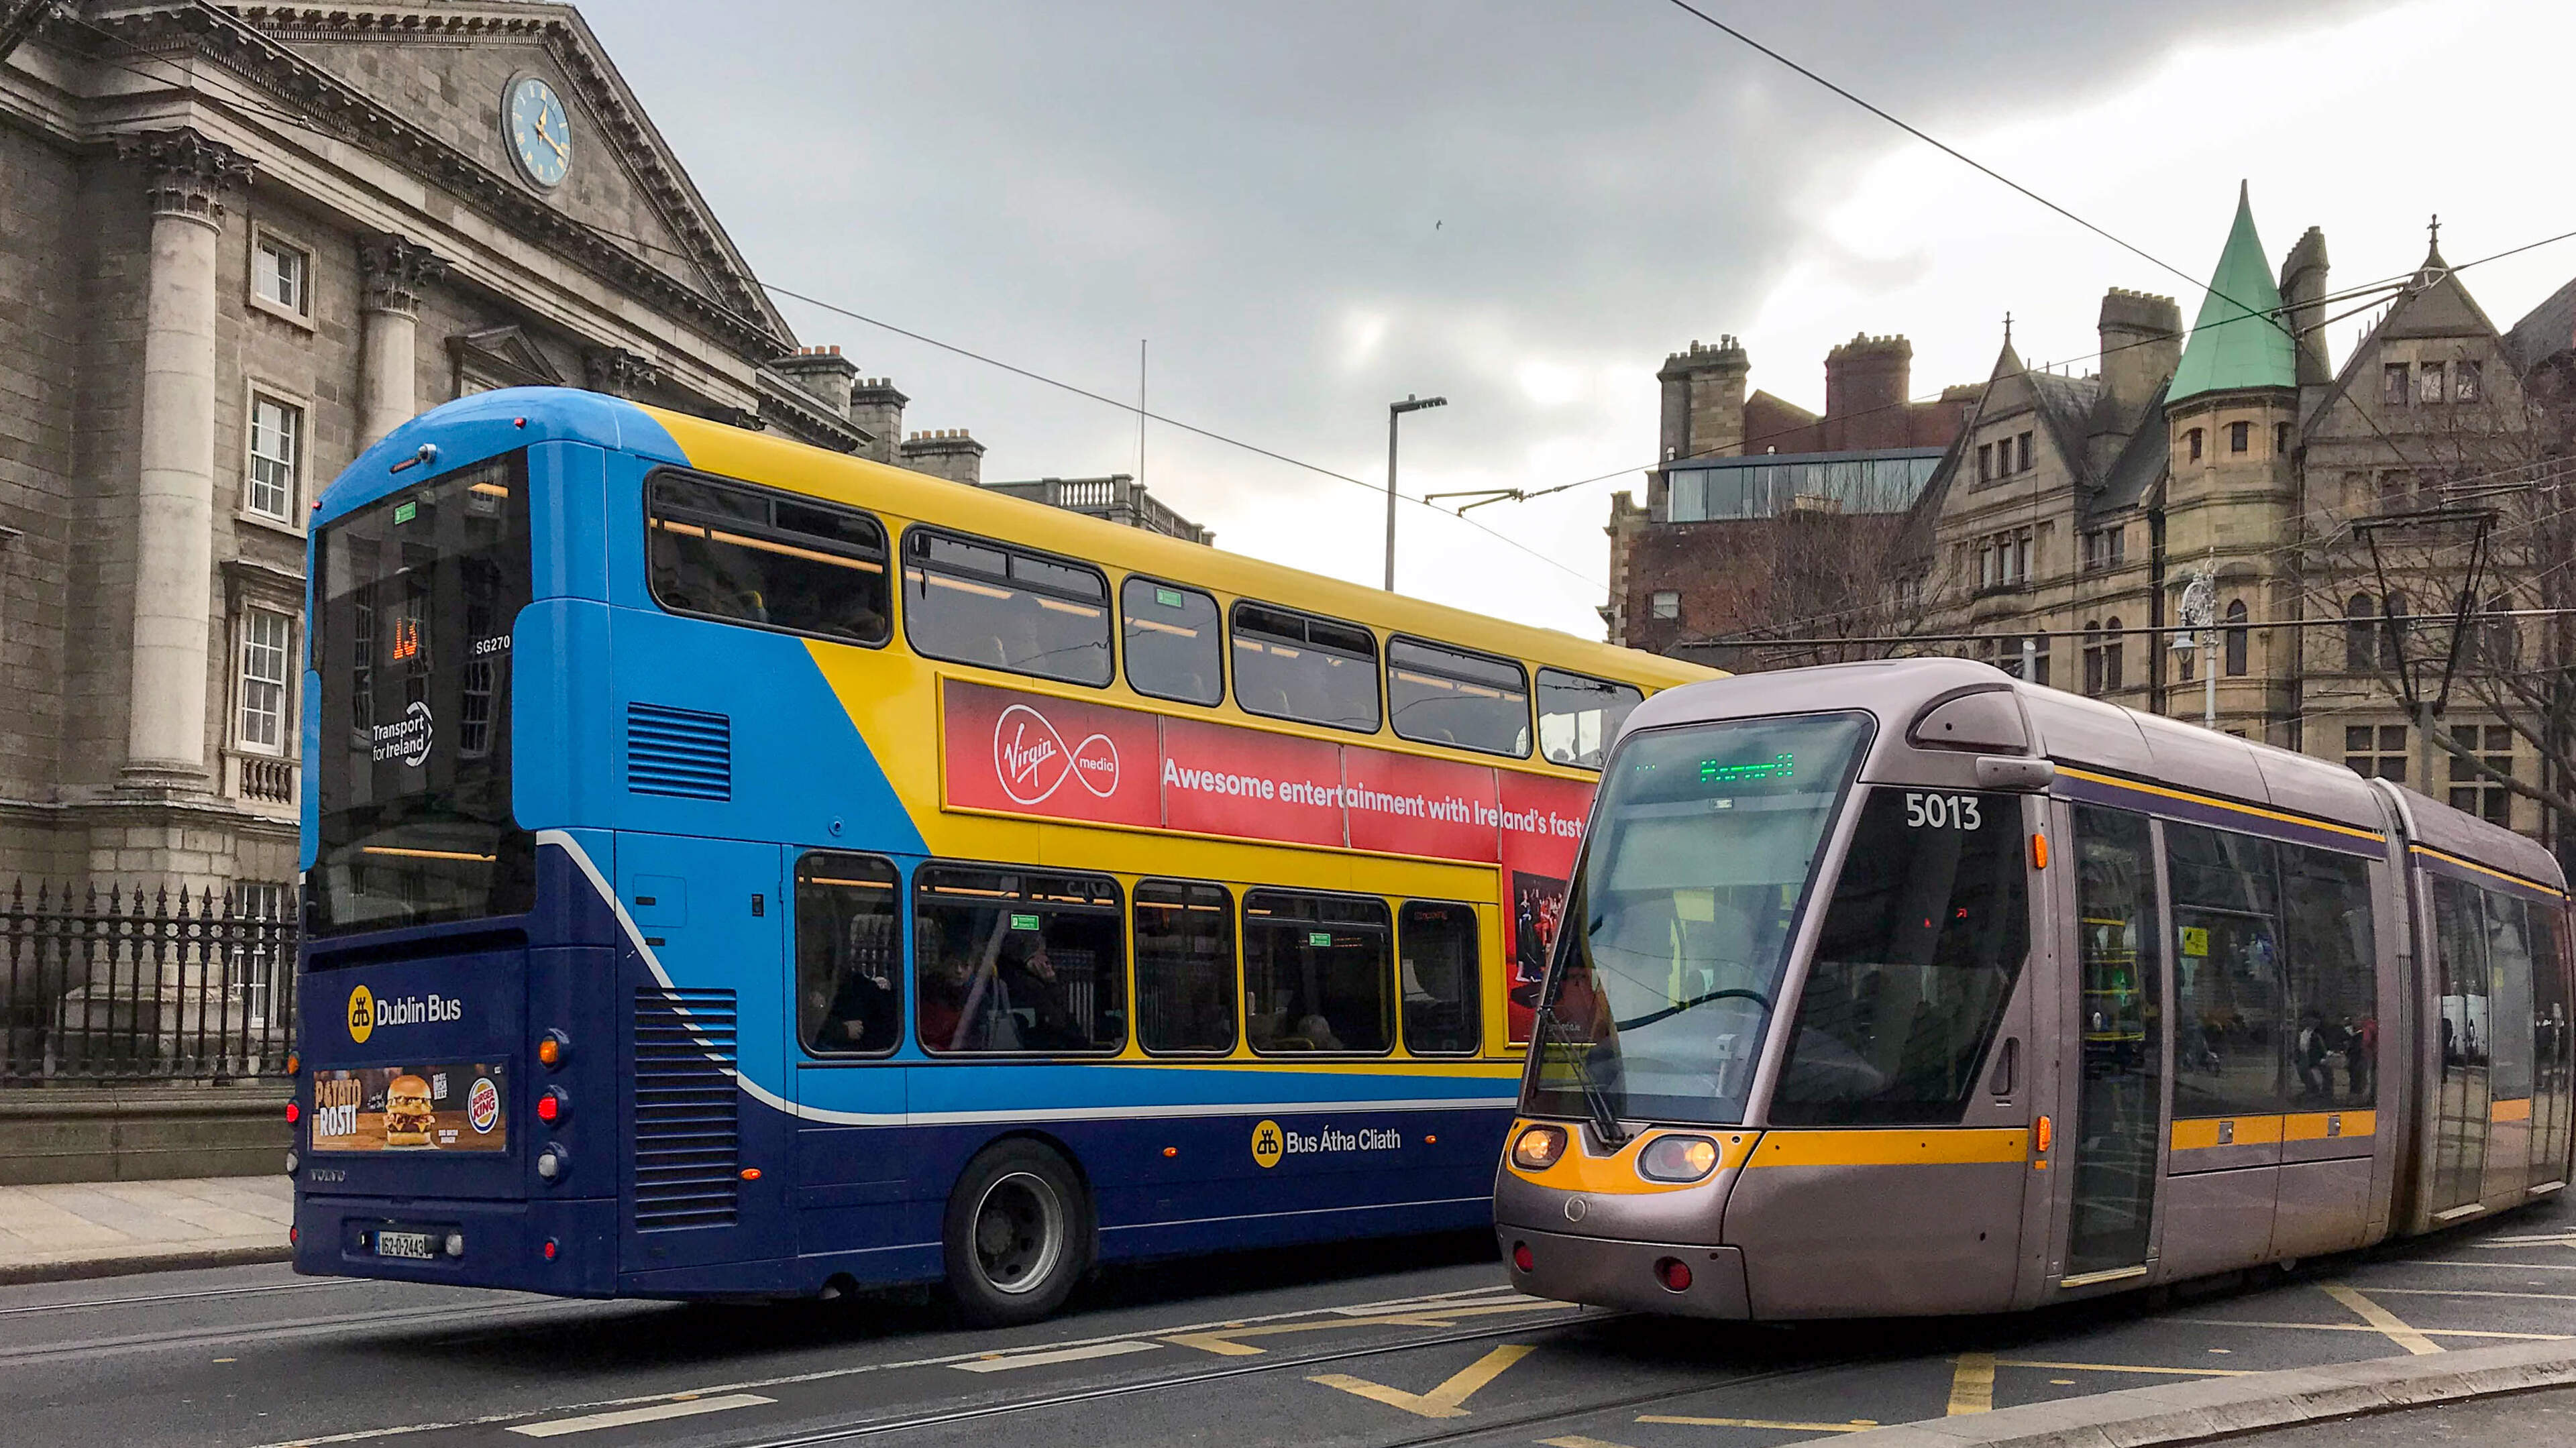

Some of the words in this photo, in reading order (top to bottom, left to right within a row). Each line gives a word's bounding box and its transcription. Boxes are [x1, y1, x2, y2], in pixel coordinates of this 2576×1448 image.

[476, 635, 511, 655] SG270
[373, 714, 425, 742] Transport
[373, 743, 385, 762] for
[386, 734, 424, 757] Ireland
[1004, 722, 1057, 787] Virgin
[1079, 757, 1114, 773] media
[1163, 759, 1274, 799] Awesome
[1279, 780, 1425, 818] entertainment
[1429, 800, 1470, 824] with
[1474, 801, 1546, 834] Ireland's
[1550, 811, 1585, 838] fast
[1907, 793, 1982, 831] 5013
[376, 997, 425, 1026] Dublin
[428, 994, 462, 1021] Bus
[472, 1089, 494, 1108] BURGER
[473, 1098, 495, 1121] KING
[320, 1105, 356, 1136] ROSTI
[1287, 1131, 1317, 1154] Bus
[1320, 1125, 1356, 1152] Átha
[1358, 1129, 1401, 1150] Cliath
